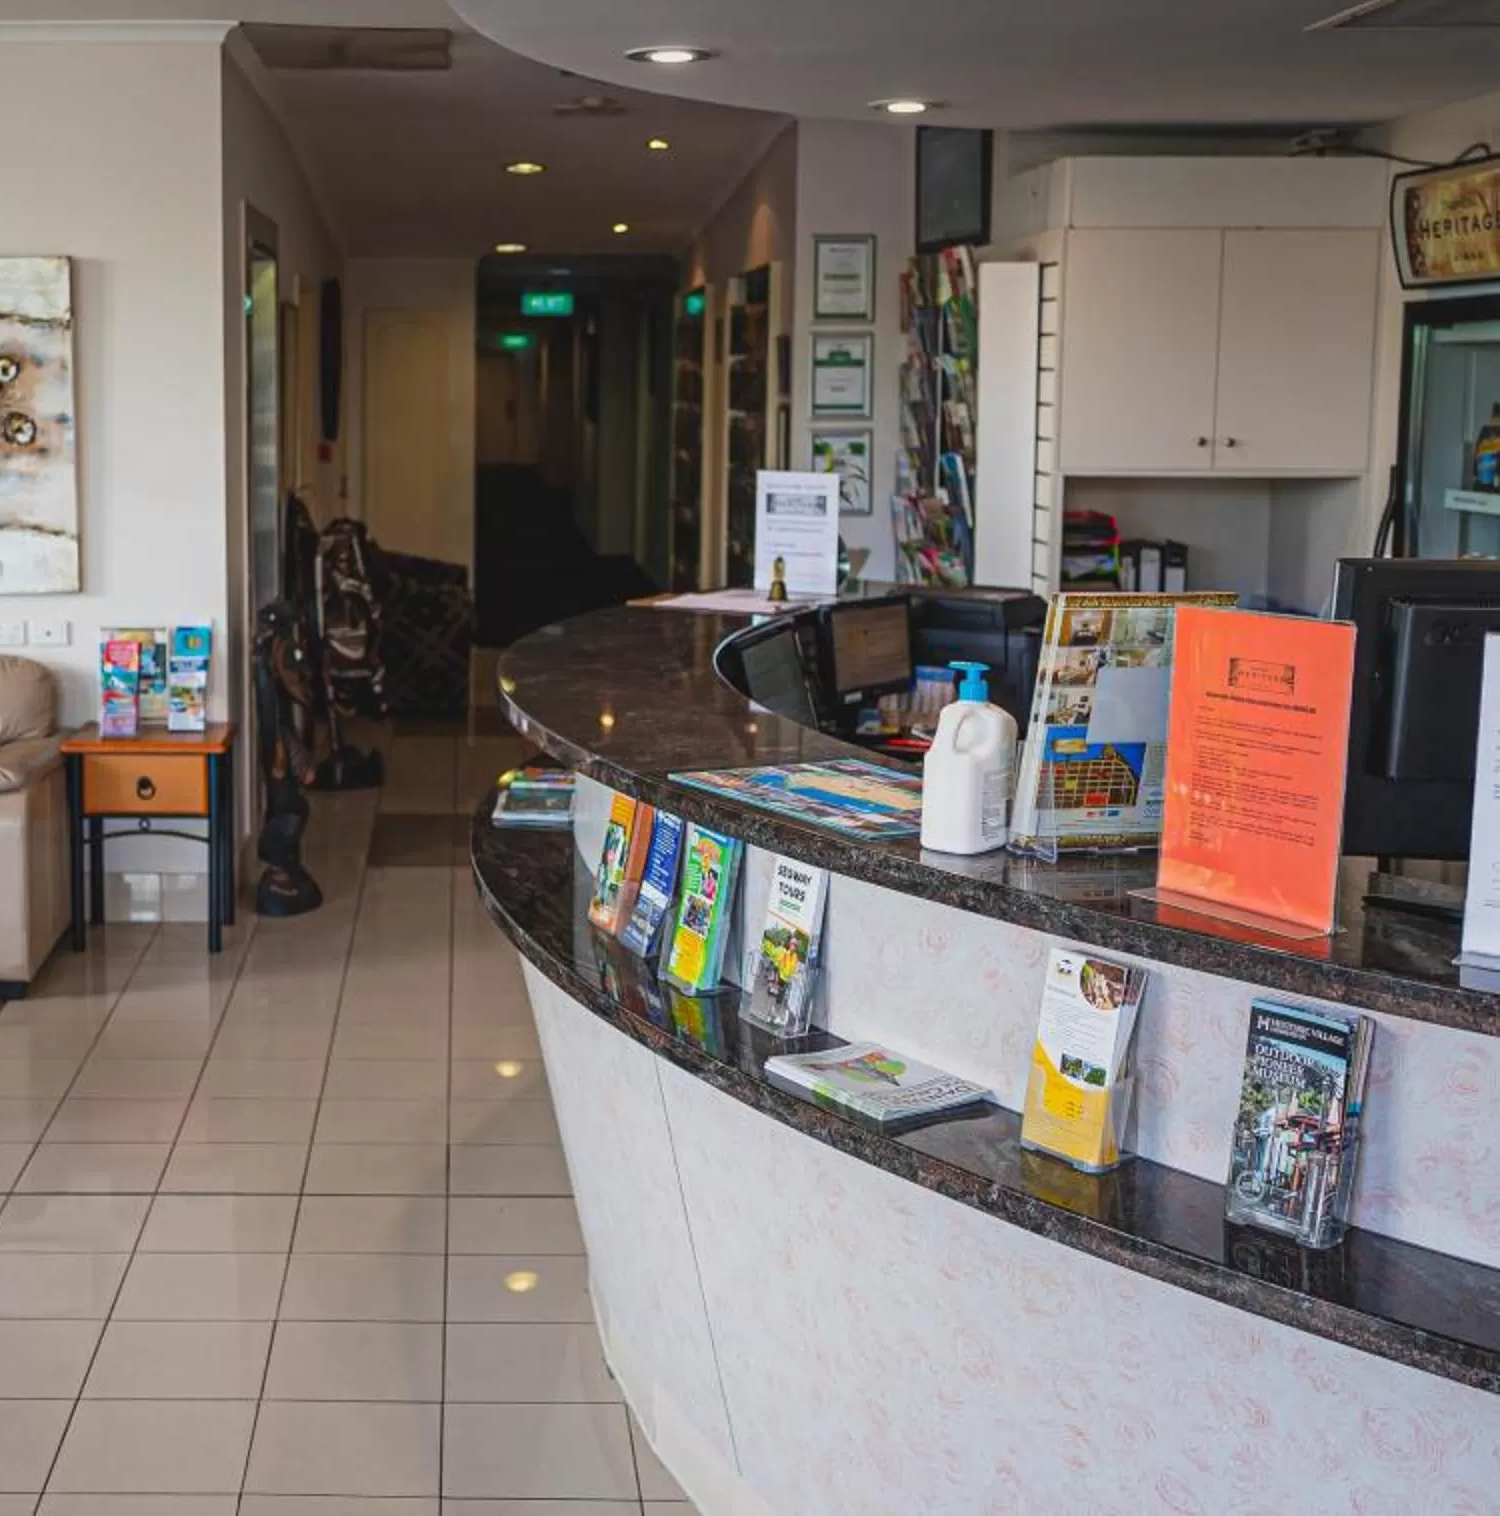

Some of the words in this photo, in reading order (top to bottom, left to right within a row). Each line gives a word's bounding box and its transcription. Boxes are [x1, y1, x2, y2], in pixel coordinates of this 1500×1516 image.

[778, 864, 812, 886] SEGWAY
[779, 881, 806, 902] TOURS
[1255, 1044, 1314, 1067] OUTDOOR
